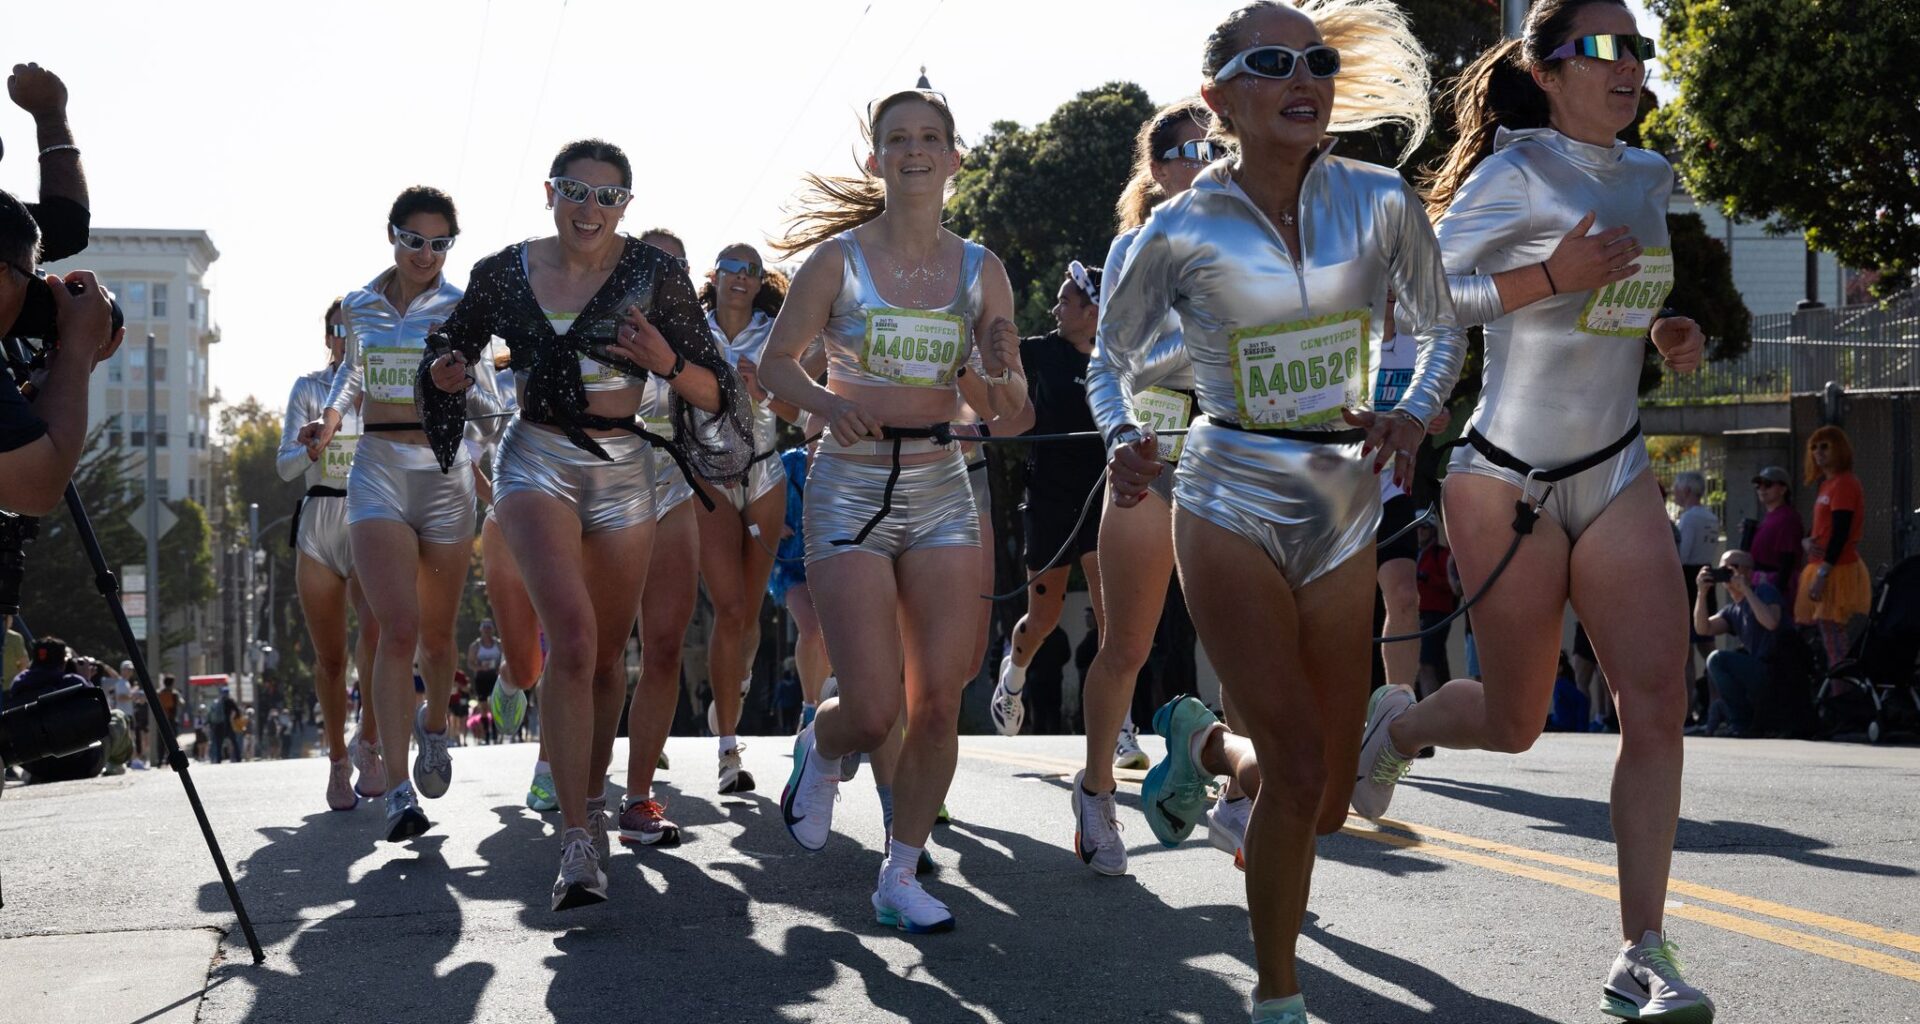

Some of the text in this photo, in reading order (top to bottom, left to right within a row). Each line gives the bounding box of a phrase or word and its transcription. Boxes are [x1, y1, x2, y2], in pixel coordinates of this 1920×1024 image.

[872, 334, 955, 364] A40530
[1300, 327, 1357, 351] CENTIPEDE
[370, 367, 417, 386] A4053
[1249, 347, 1358, 398] A40526
[328, 451, 353, 466] A40
